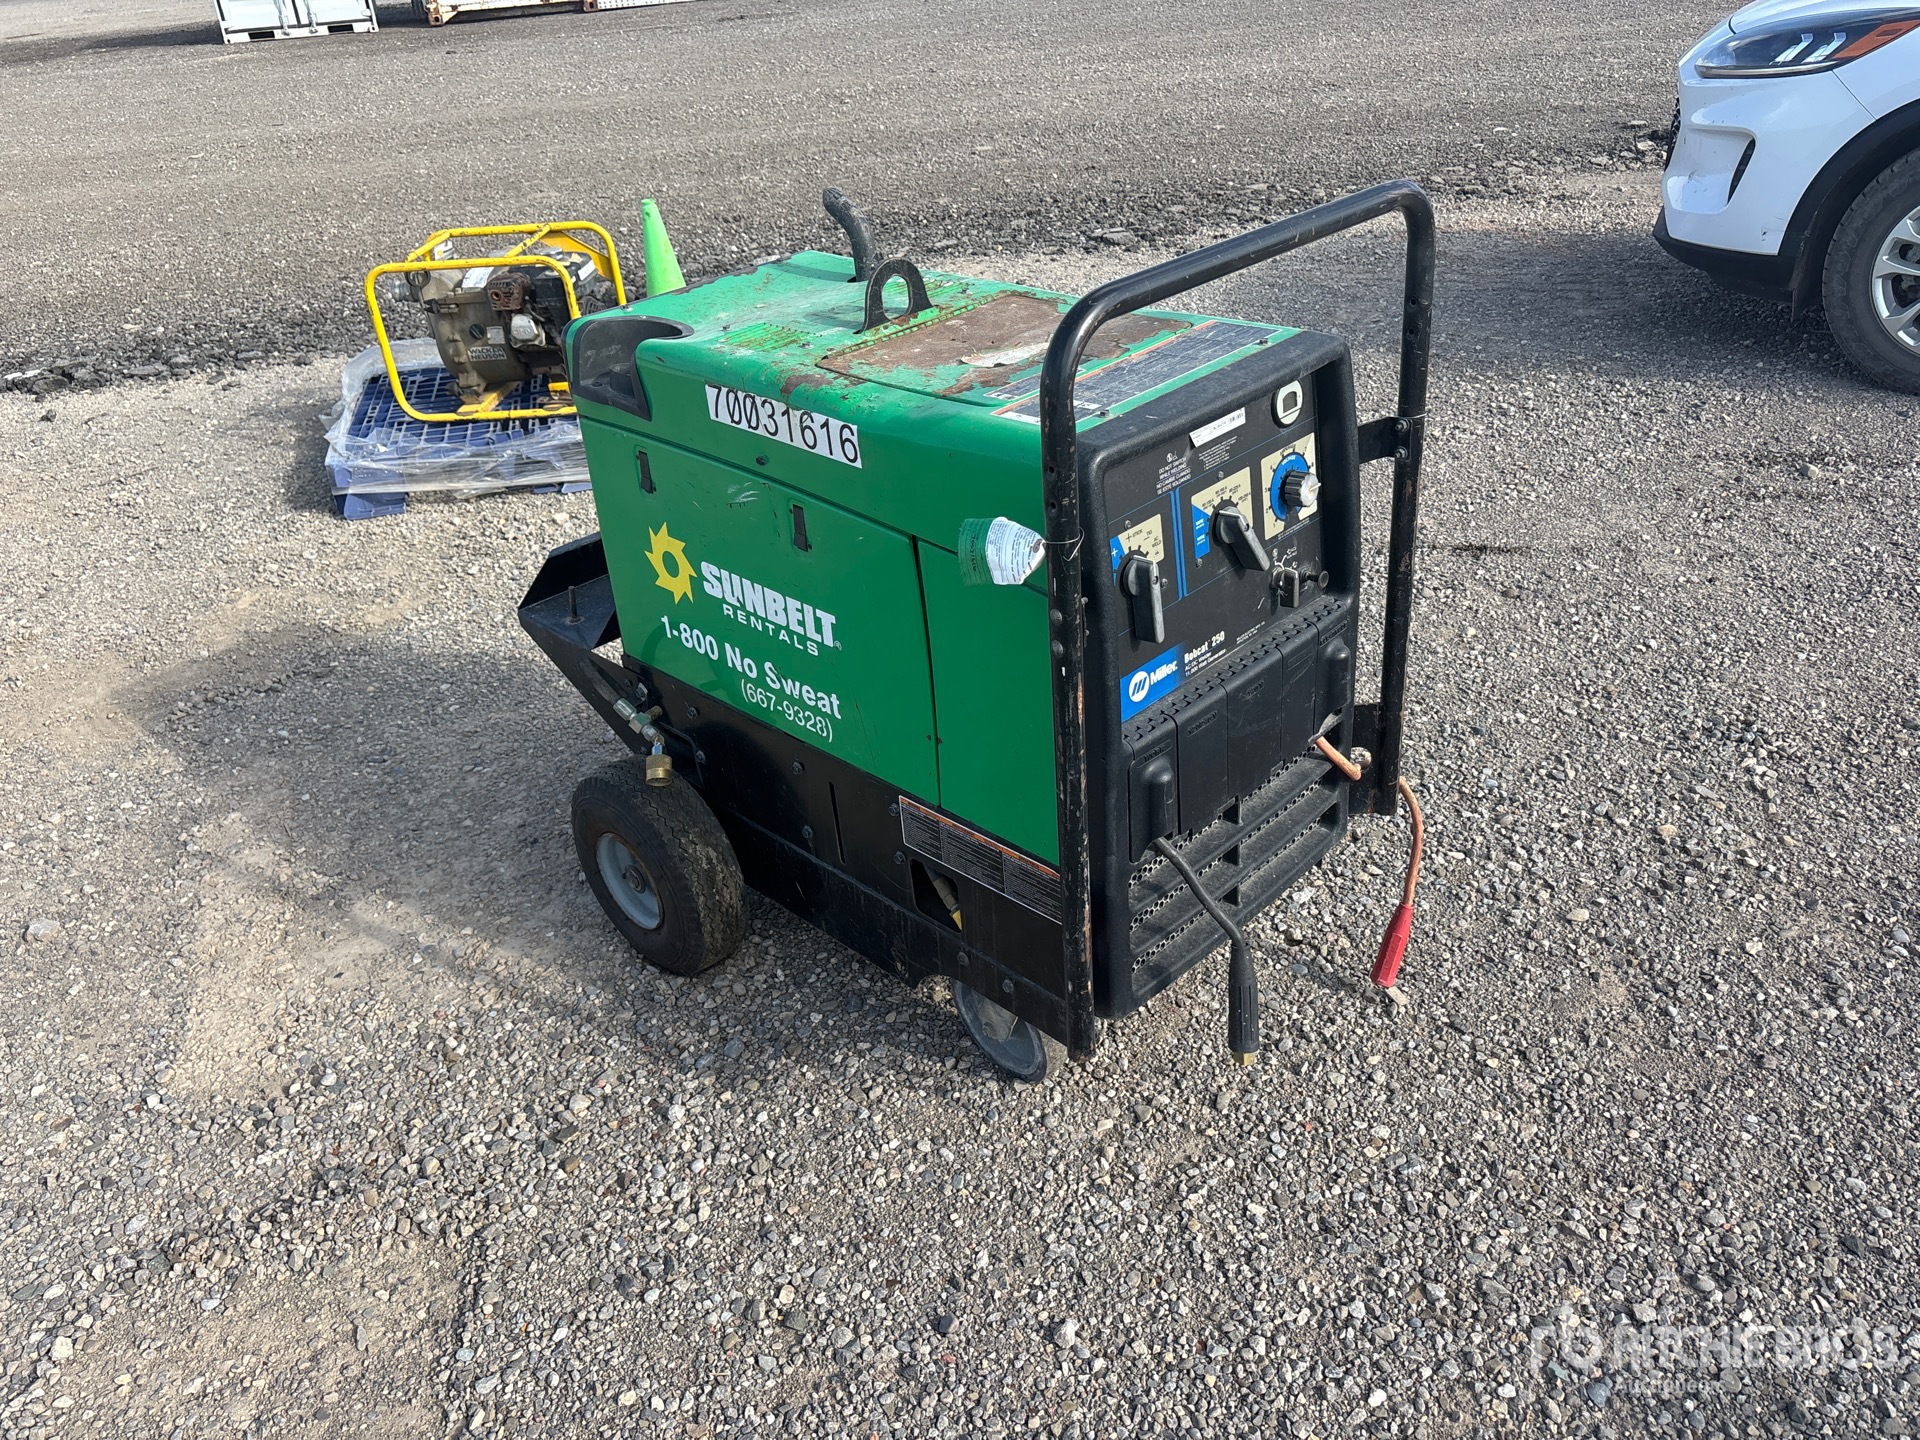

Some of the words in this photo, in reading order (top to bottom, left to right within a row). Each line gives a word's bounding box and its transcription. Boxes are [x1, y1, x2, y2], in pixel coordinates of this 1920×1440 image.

[707, 384, 859, 464] 70031616
[700, 560, 837, 648] SUNBELT
[722, 603, 820, 657] RENTALS
[660, 615, 720, 661] 1-800
[724, 642, 758, 679] No
[763, 661, 842, 720] Sweat
[1184, 641, 1210, 664] Bobcat
[1211, 630, 1226, 647] 250
[740, 678, 834, 743] (667-9328)
